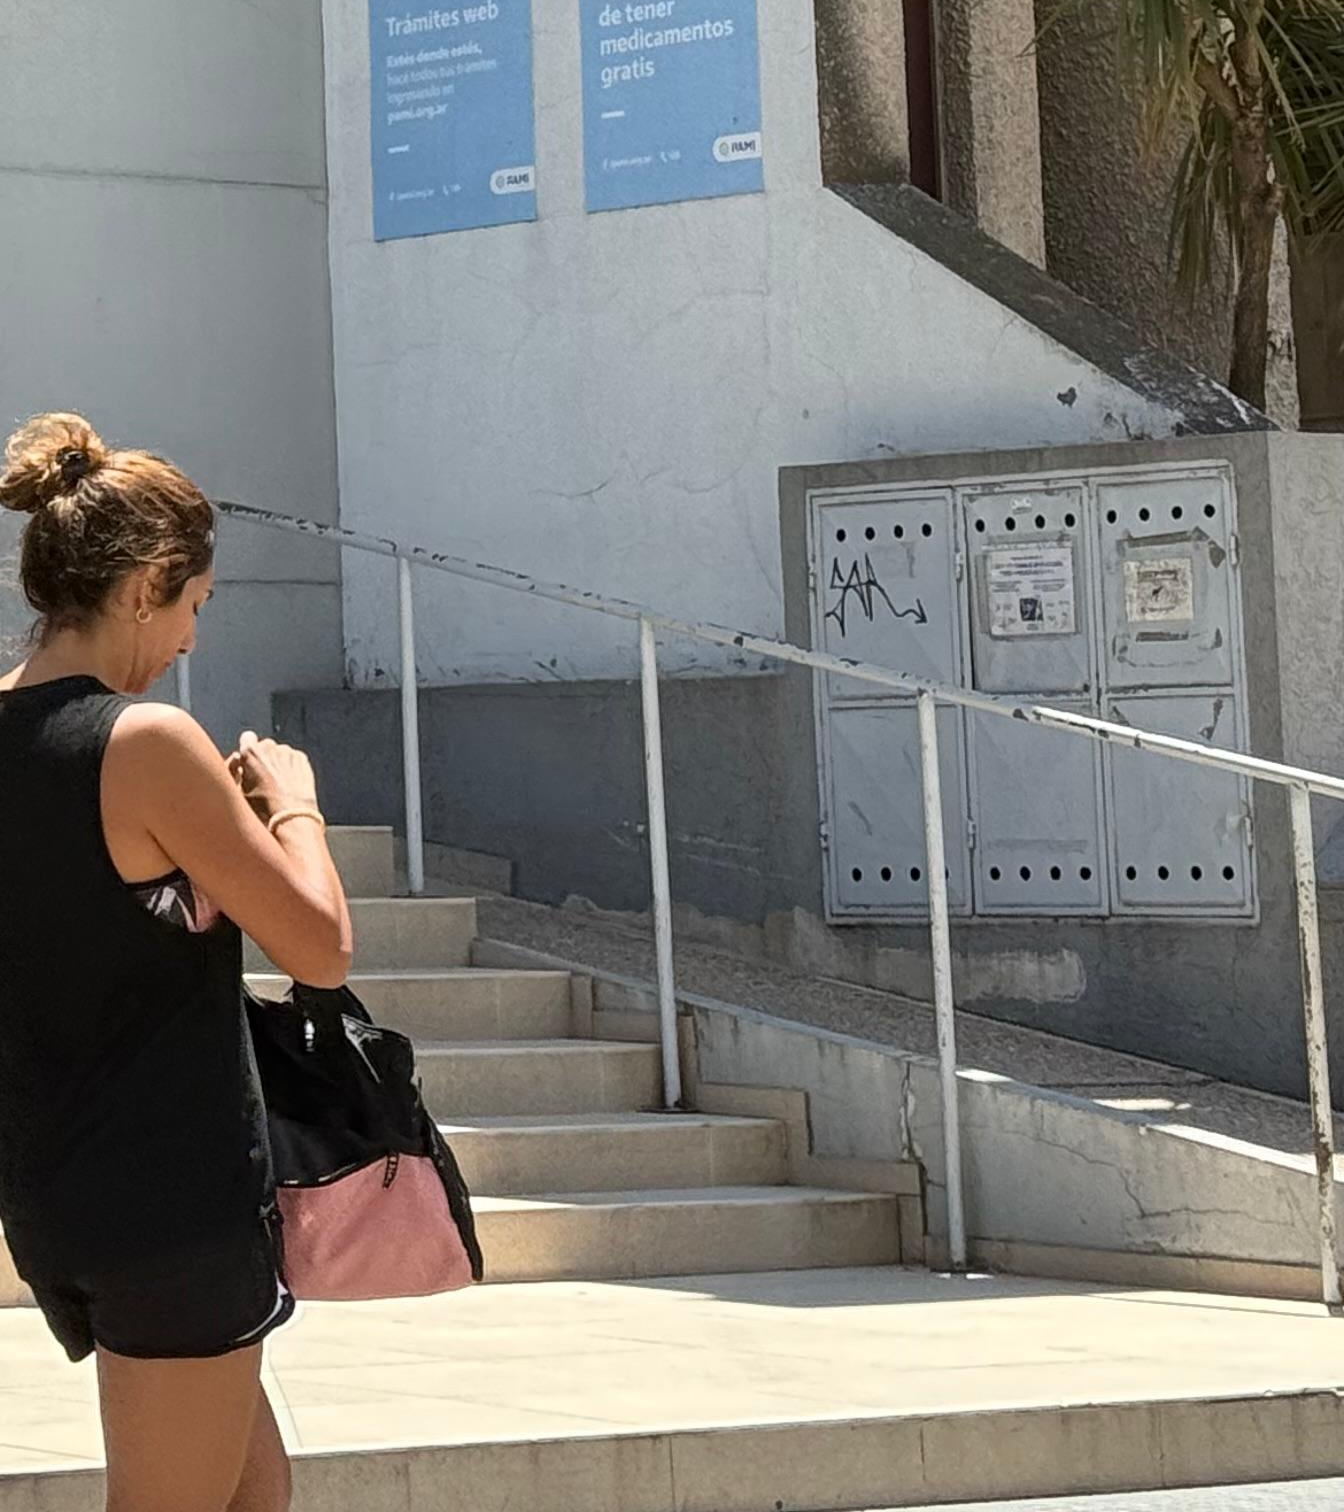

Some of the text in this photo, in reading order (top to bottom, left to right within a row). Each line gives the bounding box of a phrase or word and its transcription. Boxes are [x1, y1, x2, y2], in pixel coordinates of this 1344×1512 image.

[385, 8, 460, 37] Trámites
[599, 0, 675, 27] de tener
[600, 19, 734, 56] medicamentos
[601, 56, 655, 89] gratis
